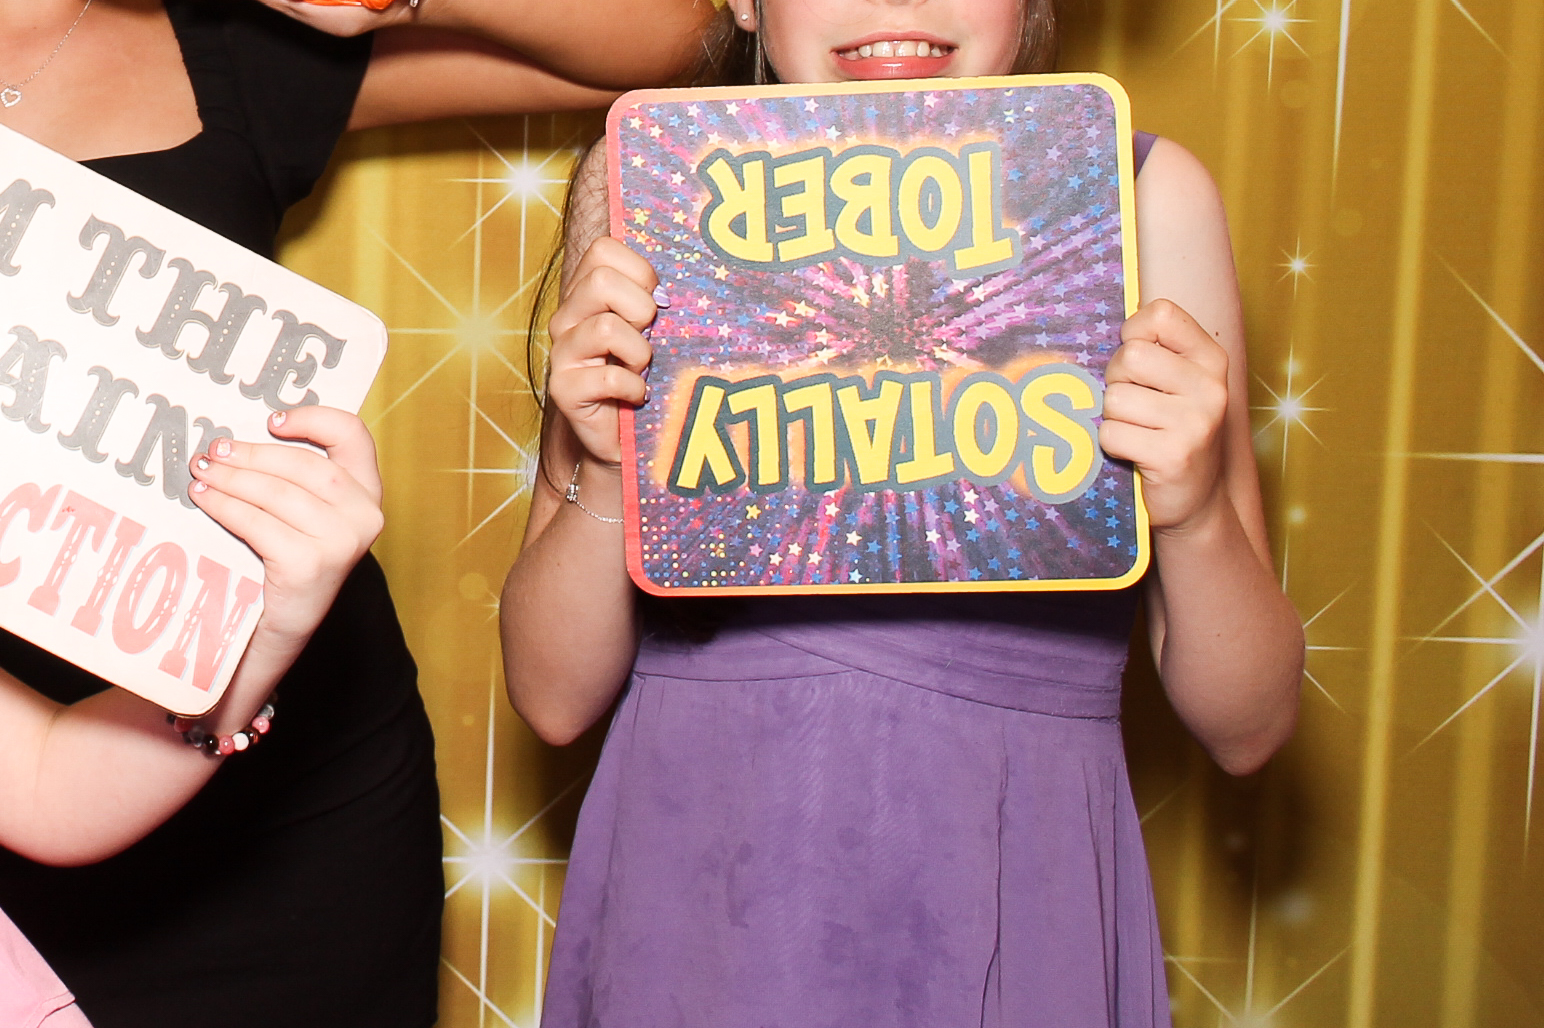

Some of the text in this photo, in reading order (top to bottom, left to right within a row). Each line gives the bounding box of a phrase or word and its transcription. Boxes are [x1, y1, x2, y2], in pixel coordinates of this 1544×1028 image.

[699, 143, 1021, 277] TOBER
[66, 213, 348, 413] THE
[670, 365, 1102, 501] SOTALLY
